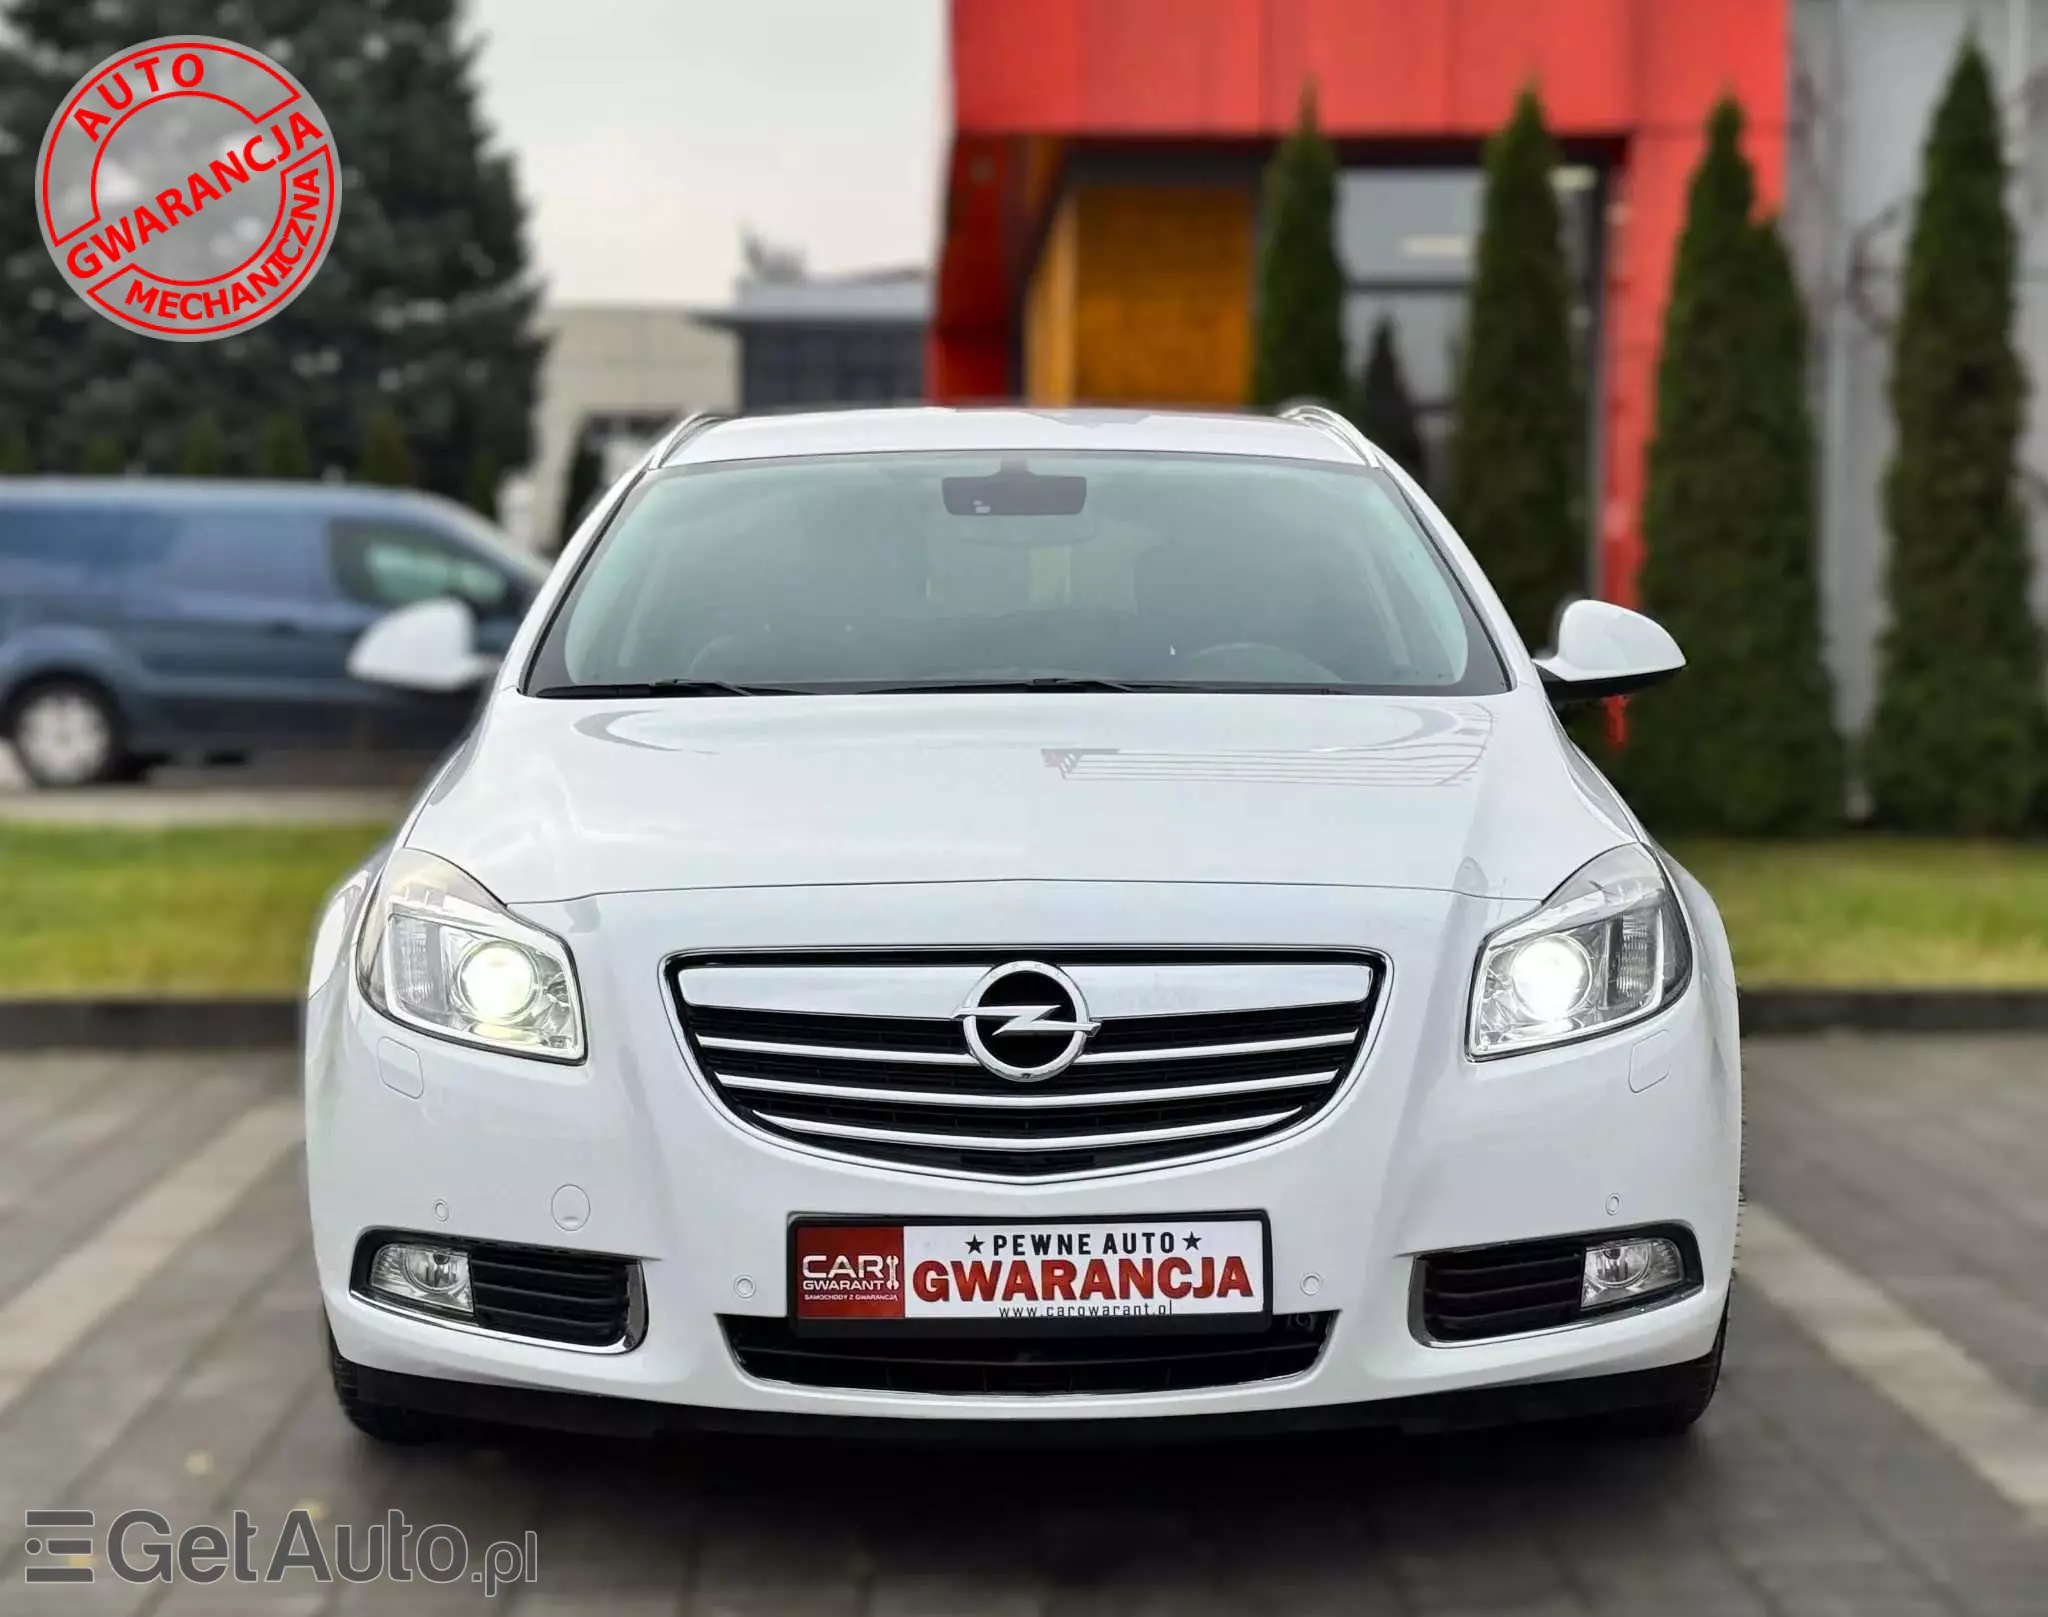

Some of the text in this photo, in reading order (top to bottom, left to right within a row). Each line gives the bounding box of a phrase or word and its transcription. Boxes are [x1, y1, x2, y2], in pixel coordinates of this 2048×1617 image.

[993, 1232, 1175, 1256] PEWNE AUTO
[802, 1255, 884, 1279] CAR
[912, 1256, 1253, 1302] GWARANCJA
[803, 1280, 884, 1291] GWARANT
